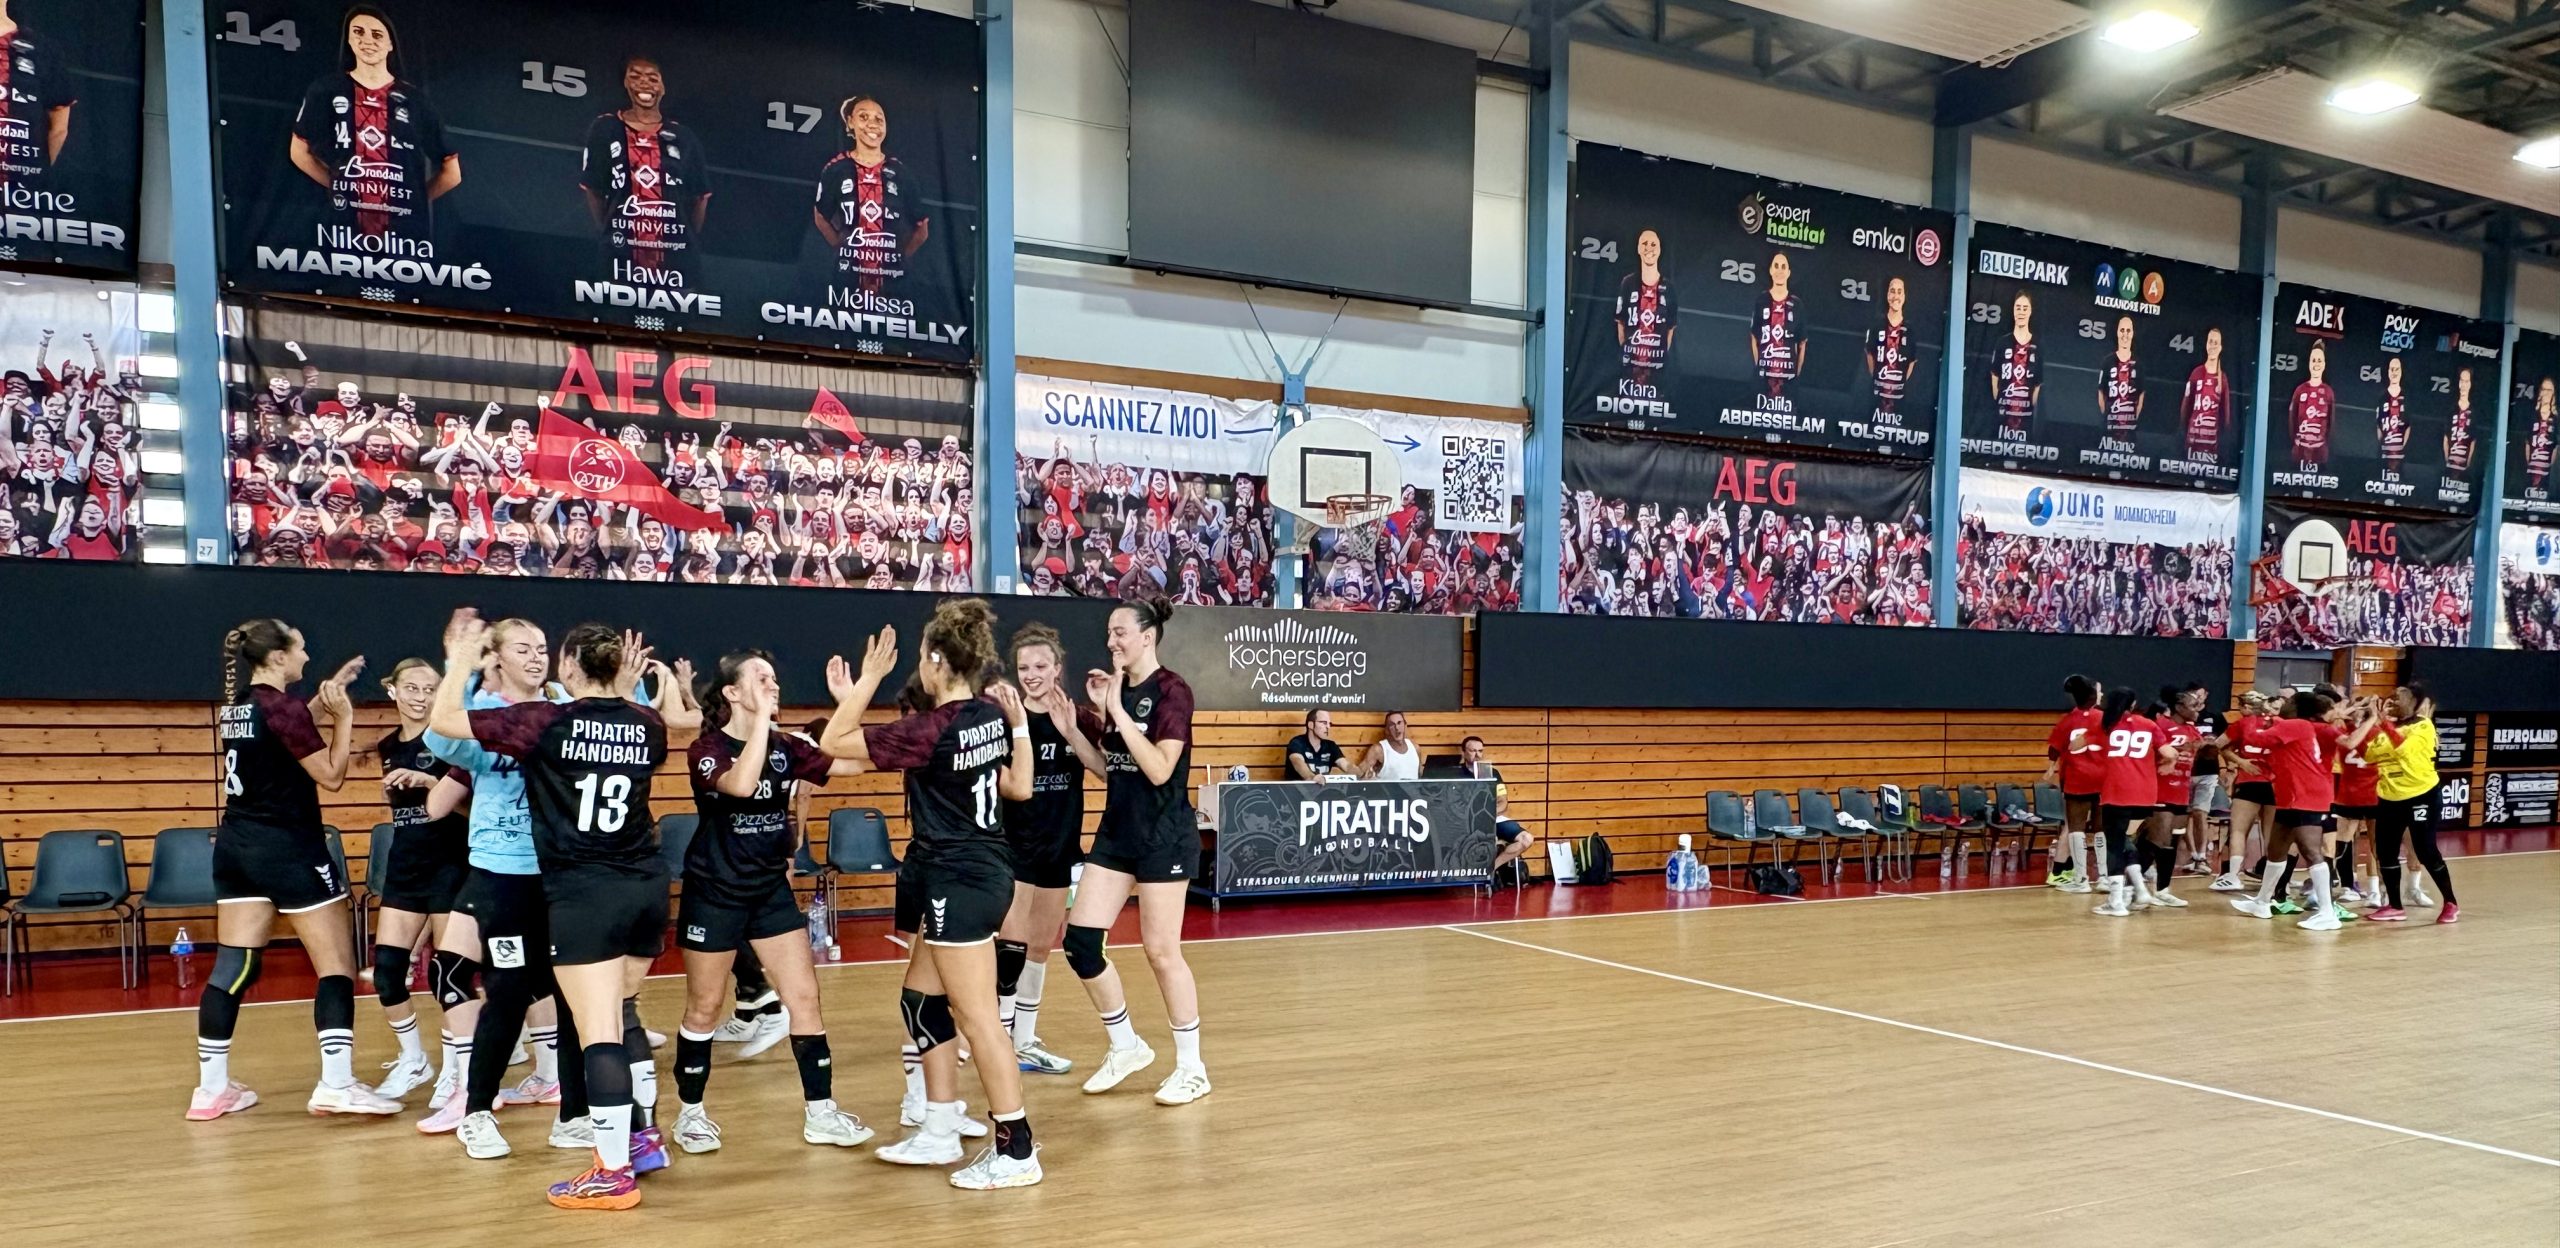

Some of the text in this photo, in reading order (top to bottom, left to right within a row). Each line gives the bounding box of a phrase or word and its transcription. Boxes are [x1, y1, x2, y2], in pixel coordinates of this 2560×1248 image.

[225, 11, 300, 51] 14
[522, 60, 587, 97] 15
[767, 101, 822, 134] 17
[0, 181, 76, 213] lène
[333, 180, 413, 200] EURINVEST
[611, 218, 686, 235] EURINVEST
[1765, 203, 1811, 224] expert
[0, 213, 125, 251] RIER
[317, 222, 434, 259] Nikolina
[1766, 218, 1826, 245] habitat
[1852, 226, 1905, 254] emka
[1581, 236, 1619, 263] 24
[256, 246, 493, 291] MARKOVIĆ
[613, 258, 684, 288] Hawa
[1720, 259, 1756, 285] 26
[574, 280, 722, 317] N'DIAYE
[827, 285, 914, 317] Mélissa
[1840, 278, 1871, 302] 31
[761, 301, 968, 346] CHANTELLY
[1972, 302, 2001, 325] 33
[2295, 300, 2345, 332] ADEX
[2384, 314, 2420, 334] POLY
[2078, 318, 2107, 340] 35
[2169, 333, 2194, 354] 44
[2274, 354, 2299, 372] 53
[2359, 365, 2382, 383] 64
[552, 346, 716, 420] AEG
[1619, 378, 1657, 400] Kiara
[2430, 376, 2451, 394] 72
[1044, 391, 1217, 440] SCANNEZ MOI
[1596, 395, 1677, 419] DIOTEL
[1756, 393, 1793, 413] Dalila
[1719, 408, 1826, 434] ABDESSELAM
[1872, 407, 1904, 427] Anne
[1838, 421, 1930, 446] TOLSTRUP
[1998, 424, 2027, 442] Nora
[1960, 438, 2059, 461] SNEDKERUD
[2079, 450, 2151, 471] FRACHON
[1713, 456, 1797, 507] AEG
[2159, 458, 2239, 482] DENOYELLE
[2272, 472, 2339, 489] FARGUES
[2056, 492, 2105, 518] JUNG
[2114, 505, 2177, 525] MOMMENHEIM
[2346, 518, 2396, 556] AEG
[199, 545, 214, 556] 27
[1229, 643, 1366, 676] Kochersberg
[1251, 667, 1352, 690] Ackerland
[571, 719, 646, 744] PIRATHS
[958, 717, 1005, 750] PIRATHS
[2107, 729, 2153, 759] 99
[561, 739, 651, 765] HANDBALL
[952, 737, 1010, 771] HANDBALL
[1040, 743, 1057, 760] 27
[224, 749, 244, 797] 8
[754, 779, 773, 800] 28
[971, 769, 998, 829] 11
[574, 773, 632, 833] 13
[1299, 799, 1430, 848] PIRATHS
[1236, 875, 1301, 887] STRASBOURG
[1363, 870, 1439, 881] TRUCHTERSHEIM
[1441, 867, 1488, 877] HANDBALL
